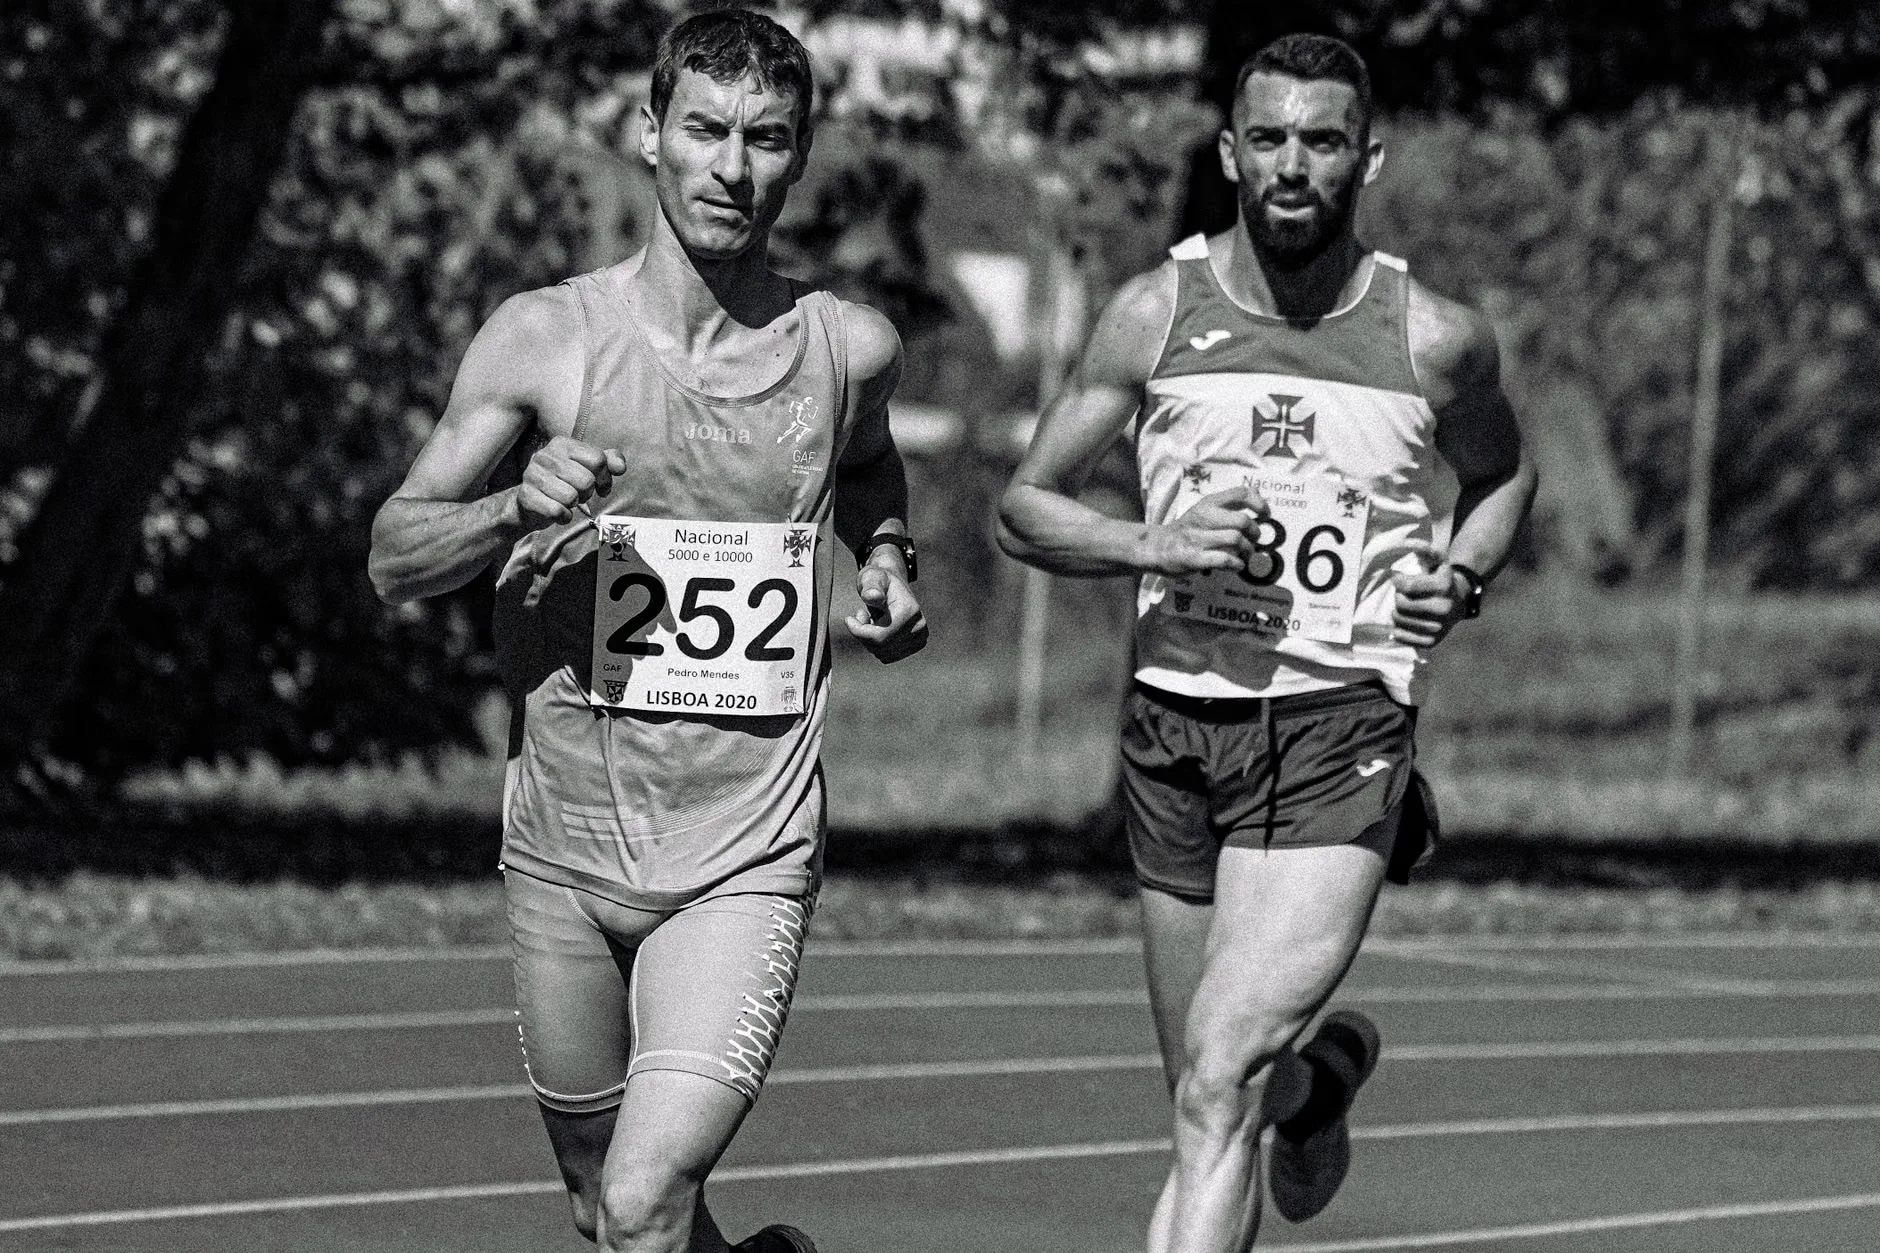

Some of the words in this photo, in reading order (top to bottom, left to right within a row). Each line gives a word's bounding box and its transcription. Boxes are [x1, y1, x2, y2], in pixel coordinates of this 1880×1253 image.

[792, 449, 817, 463] GAF
[1243, 475, 1305, 495] Nacional
[674, 529, 749, 546] Nacional
[668, 549, 700, 561] 5000
[702, 553, 710, 561] e
[714, 551, 753, 563] 10000
[1201, 516, 1346, 594] 86
[606, 572, 798, 662] 252
[1207, 603, 1260, 625] LISBOA
[603, 663, 622, 672] GAF
[667, 667, 698, 679] Pedro
[700, 669, 740, 681] Mendes
[780, 671, 794, 680] V35
[646, 690, 709, 708] LISBOA
[715, 693, 757, 710] 2020
